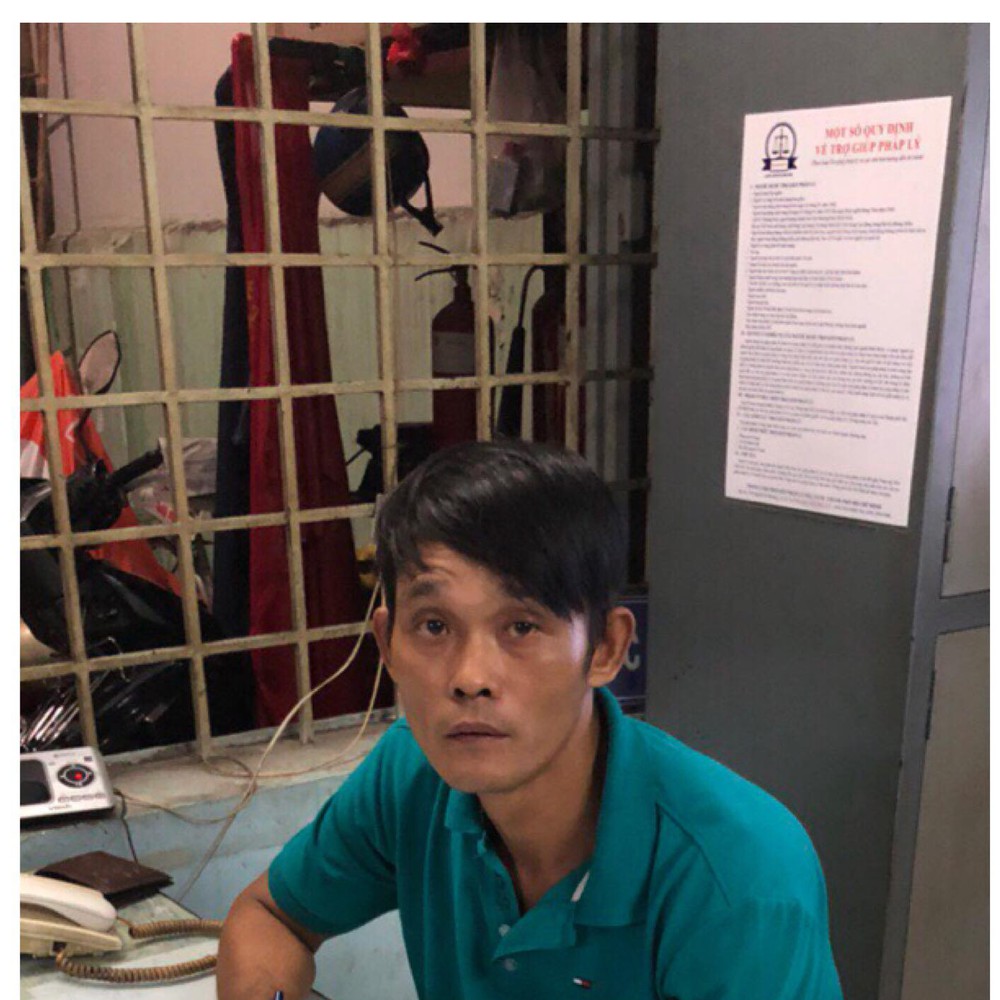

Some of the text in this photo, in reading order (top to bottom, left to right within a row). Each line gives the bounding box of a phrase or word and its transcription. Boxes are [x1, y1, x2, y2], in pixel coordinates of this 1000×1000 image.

[825, 121, 914, 142] MỘT SỐ QUY ĐỊNH
[815, 134, 921, 157] VỀ TRỢ GIÚP PHÁP LÝ
